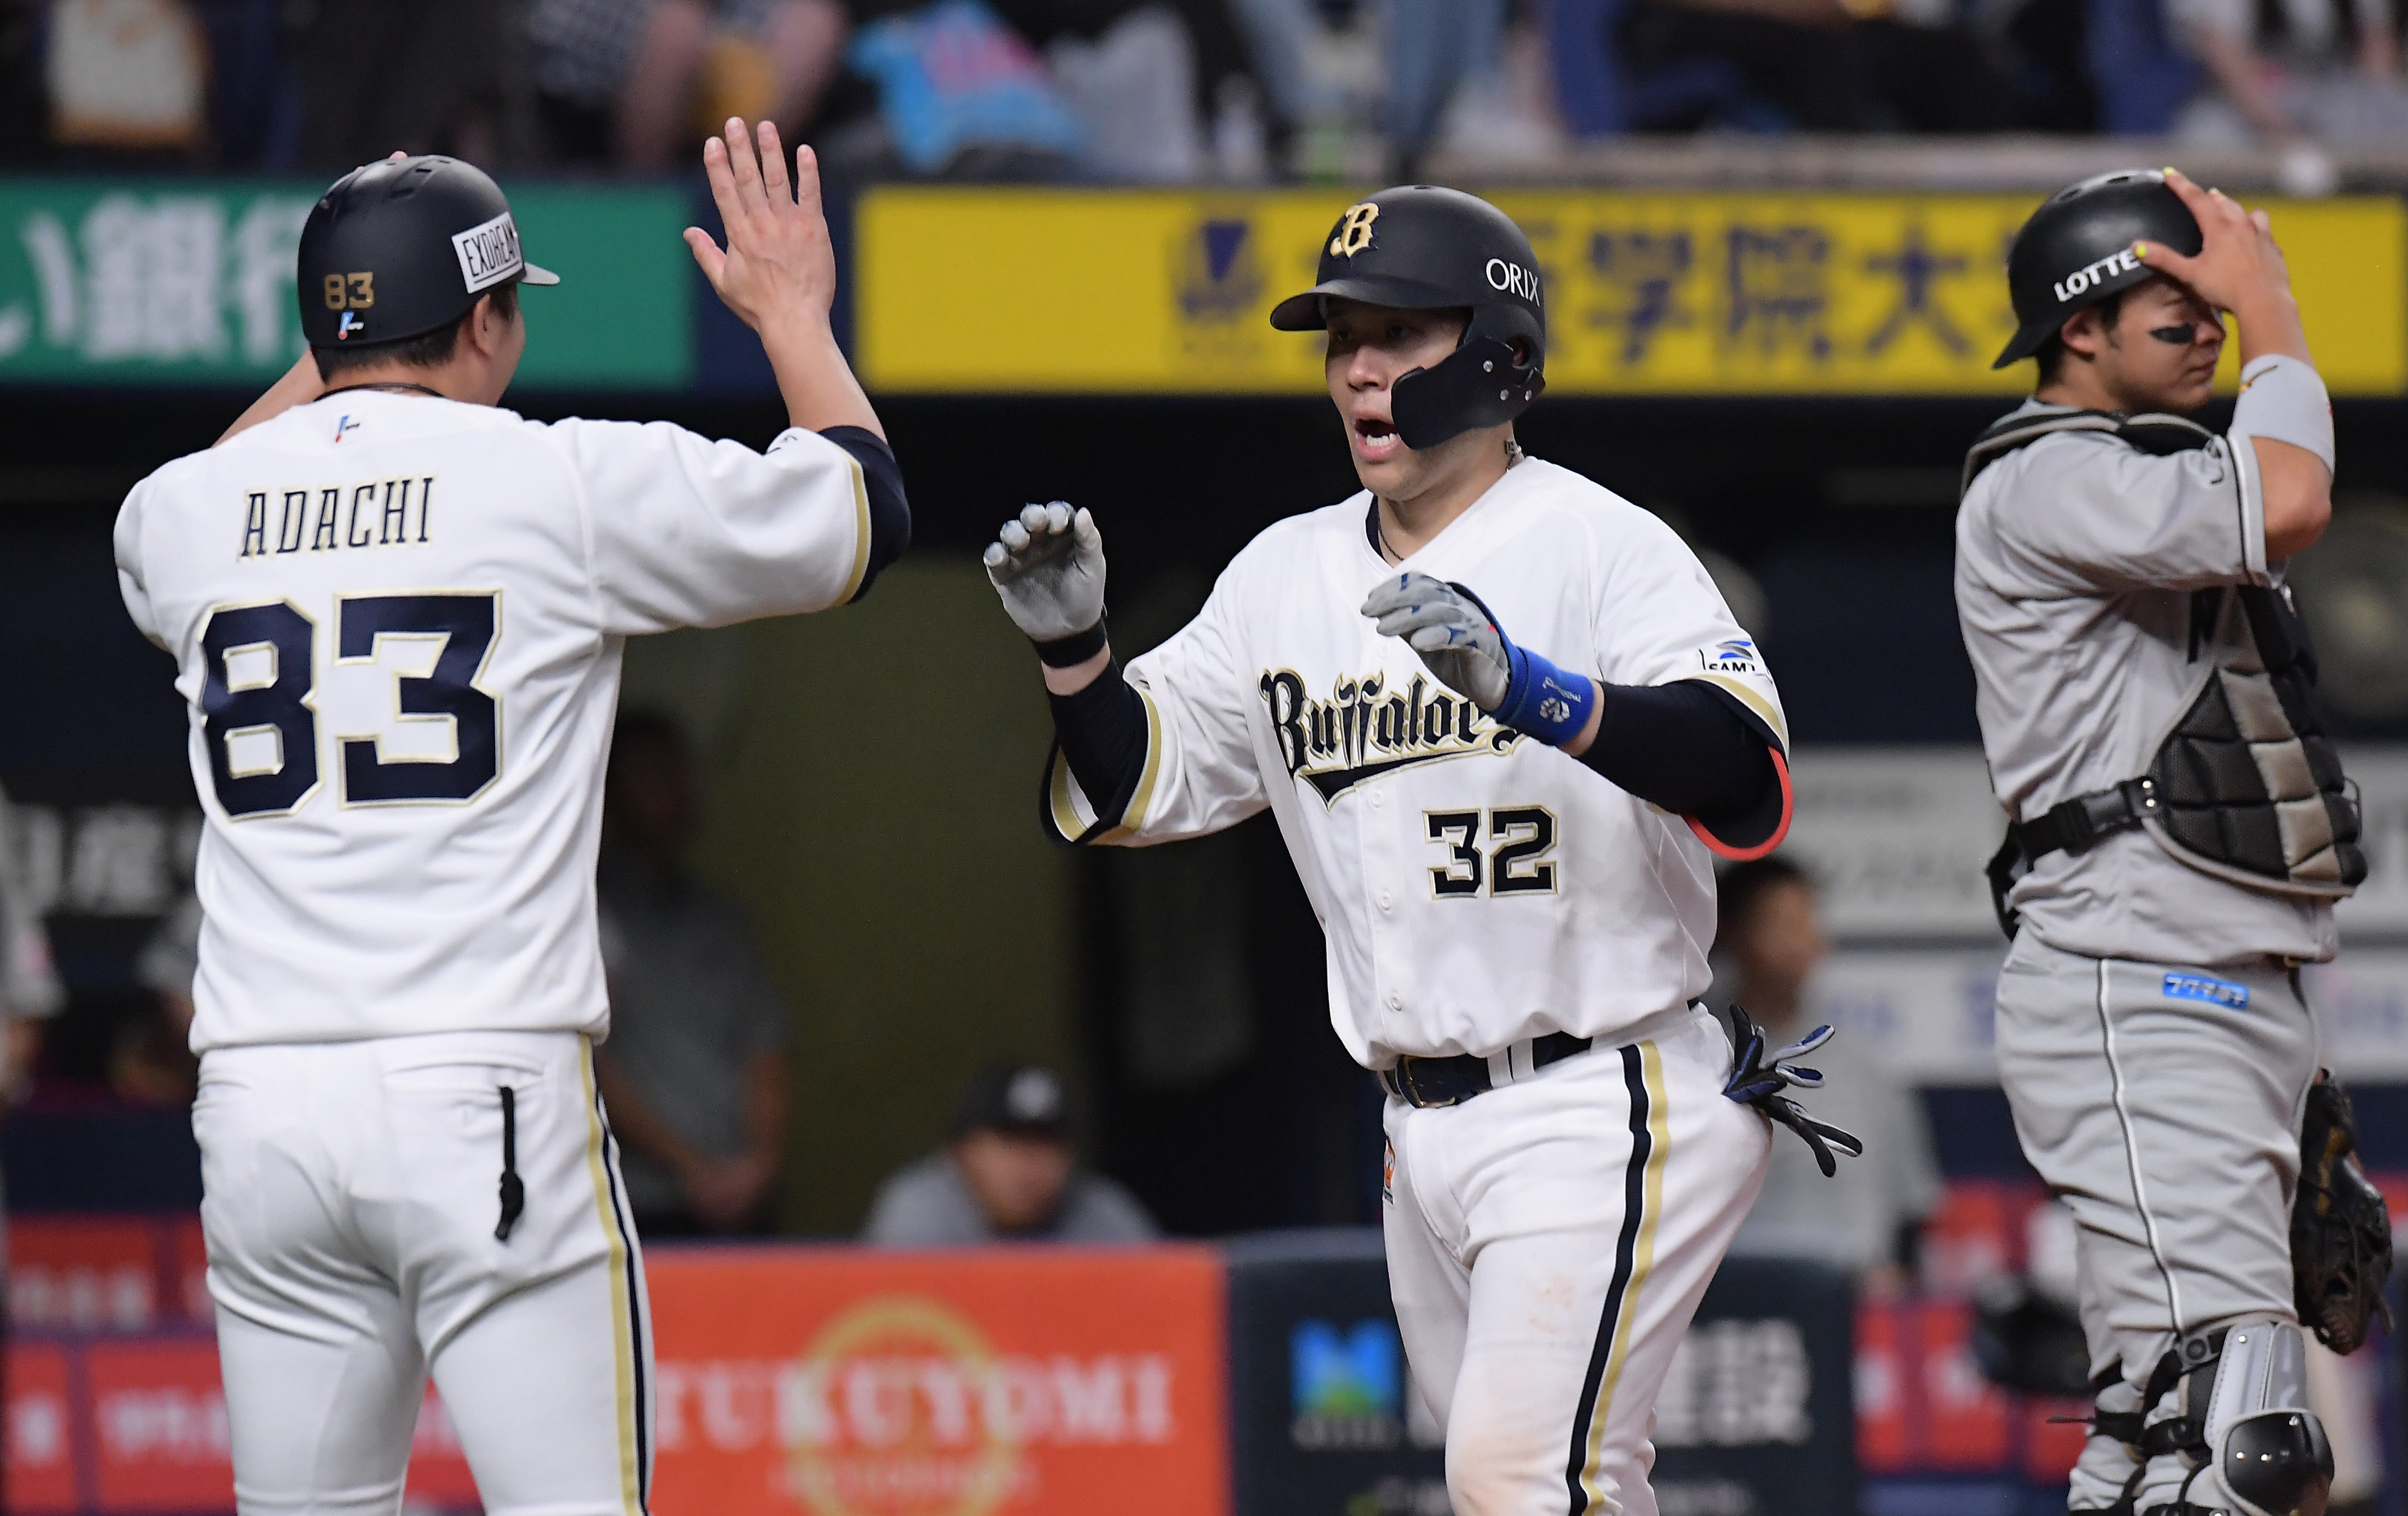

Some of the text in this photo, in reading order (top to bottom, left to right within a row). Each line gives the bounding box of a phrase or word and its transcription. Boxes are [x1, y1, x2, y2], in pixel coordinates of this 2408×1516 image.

[462, 221, 517, 278] EXDREA
[1329, 202, 1380, 259] B
[324, 271, 375, 310] 83
[1485, 258, 1540, 308] ORIX
[2053, 248, 2141, 303] LOTTE
[240, 475, 434, 558] ADACHI
[198, 588, 503, 825] 83
[1422, 803, 1558, 899] 32
